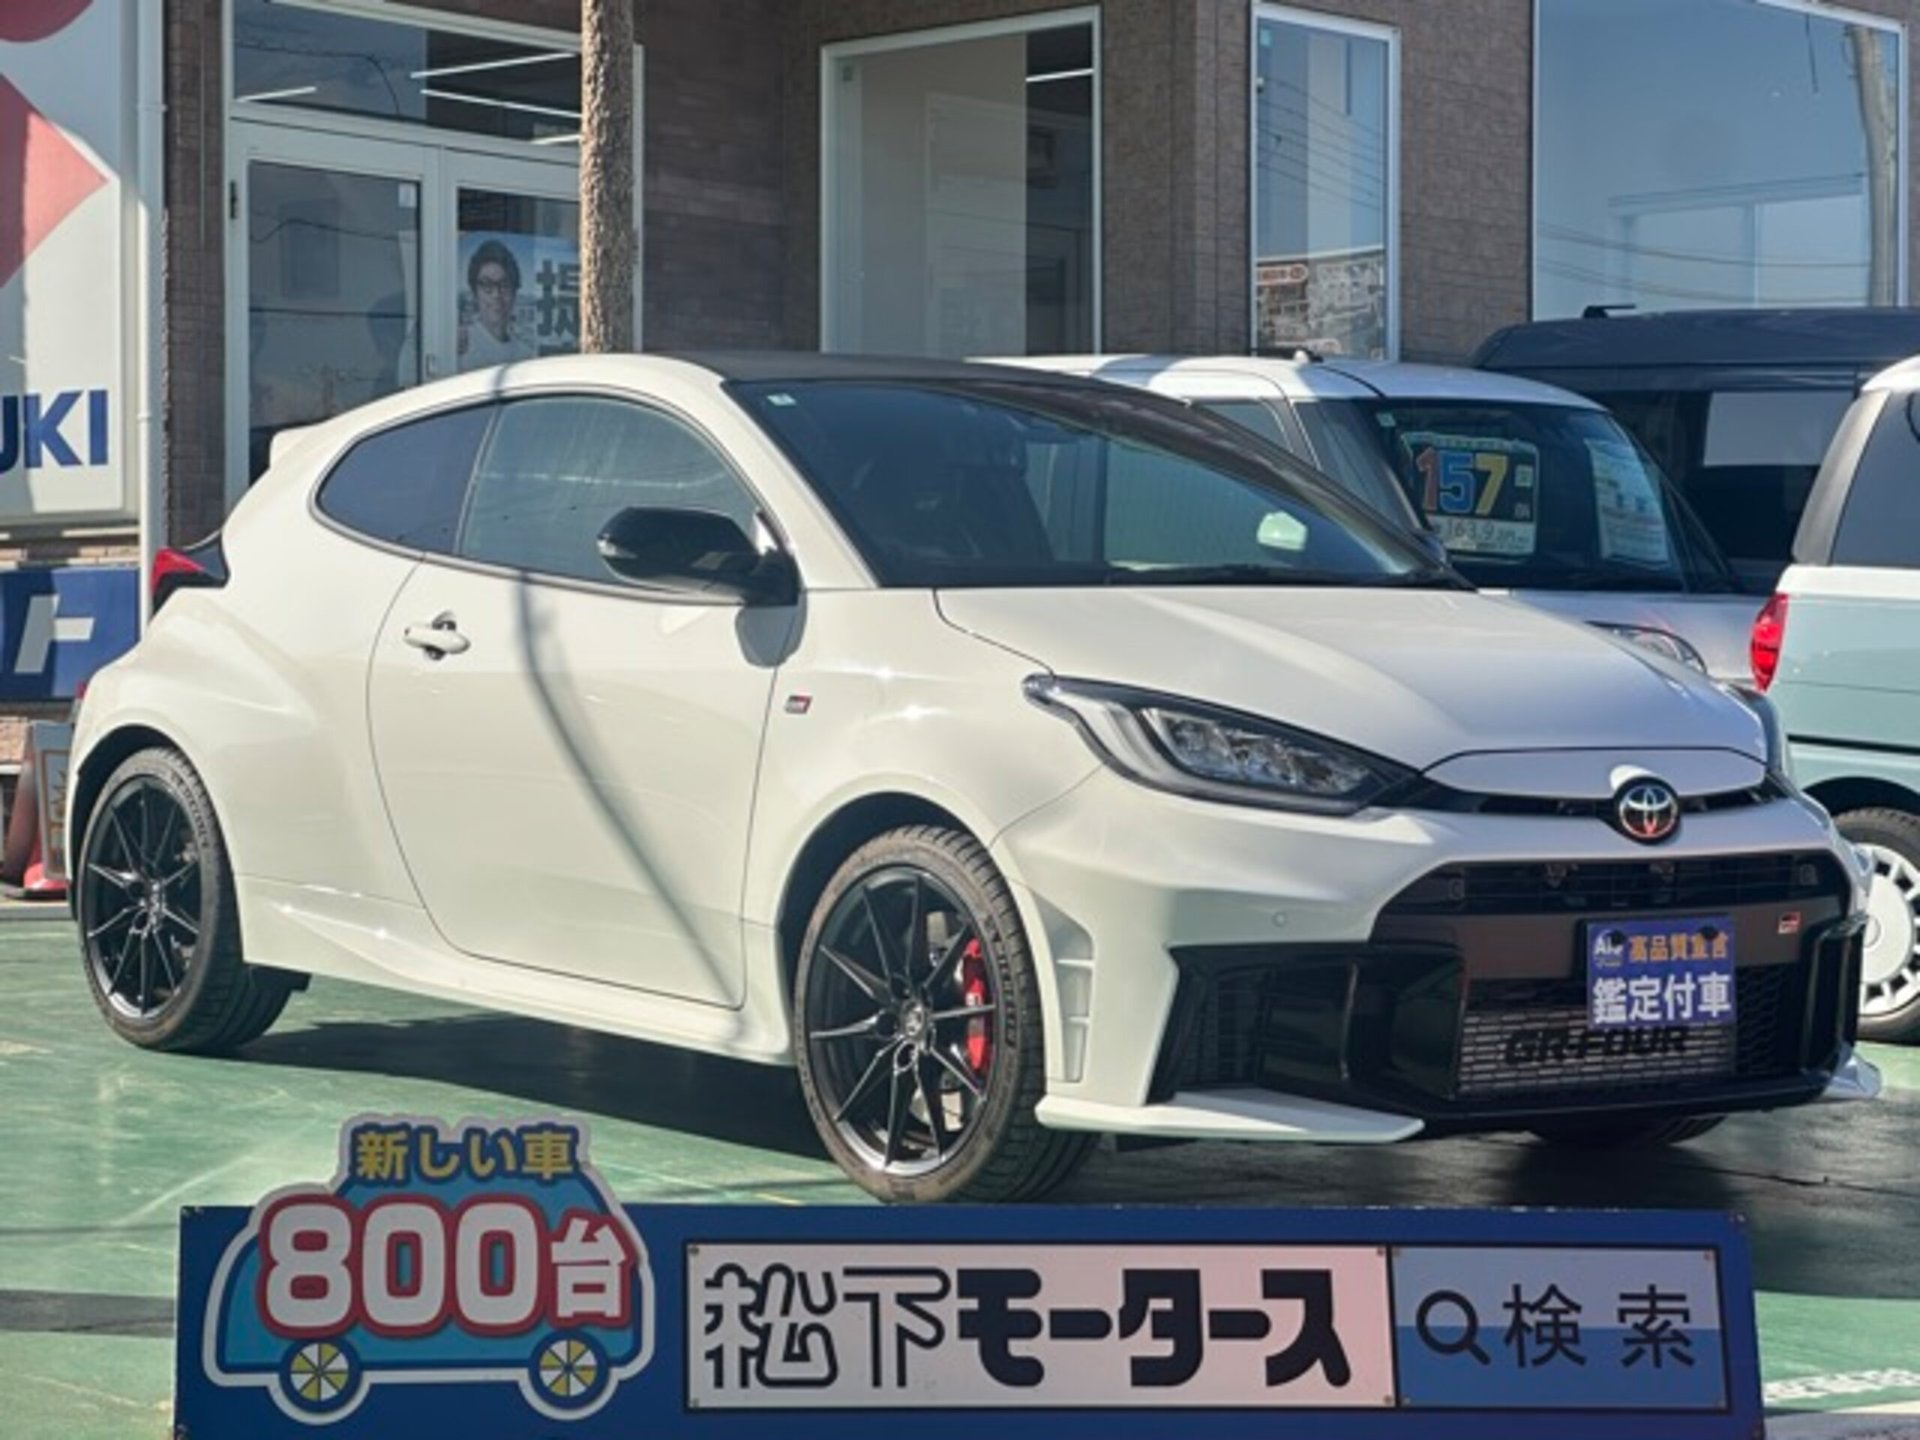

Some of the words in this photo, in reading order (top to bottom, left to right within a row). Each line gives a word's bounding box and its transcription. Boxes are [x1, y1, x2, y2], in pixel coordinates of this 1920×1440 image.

[1416, 447, 1507, 514] 157
[1593, 971, 1731, 1024] 鑑定付車
[357, 1129, 573, 1179] 新しい車
[266, 1202, 628, 1328] 800台
[703, 1262, 1352, 1390] 松下モータース
[1503, 1283, 1696, 1369] 検索
